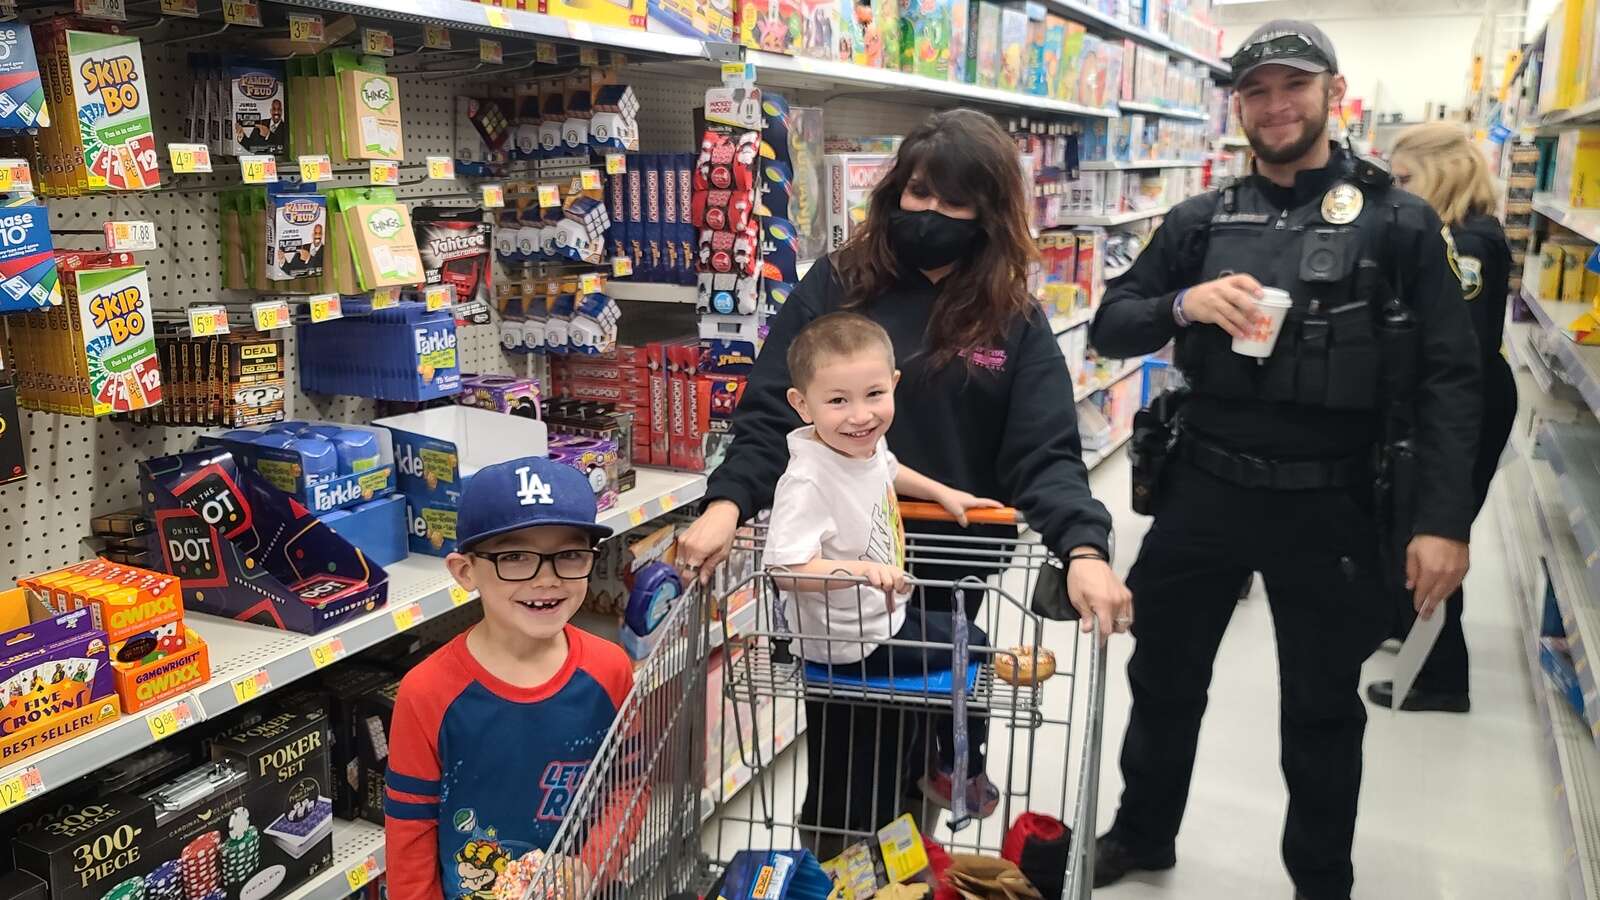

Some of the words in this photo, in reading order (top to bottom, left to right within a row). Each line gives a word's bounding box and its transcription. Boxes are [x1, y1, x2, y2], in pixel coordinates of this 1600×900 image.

[99, 83, 139, 116] BO
[137, 149, 159, 172] 12
[629, 171, 641, 222] MONOPOLY
[647, 171, 659, 222] MONOPOLY
[664, 171, 676, 223] MONOPOLY
[680, 171, 692, 223] MONOPOLY
[430, 235, 484, 256] Yahtzee
[108, 310, 145, 346] BO
[415, 328, 456, 355] Farkle
[244, 347, 274, 356] DEAL
[141, 369, 160, 392] 12
[575, 388, 620, 398] MONOPOLY
[652, 376, 664, 434] MONOPOLY
[671, 378, 684, 436] MONOPOLY
[199, 487, 216, 501] THE
[314, 480, 361, 511] Farkle
[515, 466, 554, 506] LA
[202, 489, 235, 524] OT
[184, 527, 199, 535] THE
[168, 536, 212, 564] DOT
[301, 581, 341, 598] DOT
[111, 594, 177, 629] QWIXX
[136, 661, 201, 701] QWIXX
[24, 690, 62, 712] FIVE
[2, 735, 37, 759] BEST
[41, 713, 94, 744] SELLER!
[232, 712, 297, 743] POKER
[263, 725, 289, 739] SET
[258, 730, 323, 777] POKER
[277, 758, 306, 783] SET
[45, 803, 110, 835] 300-
[64, 808, 121, 837] PIECE
[72, 825, 143, 873] 300-
[80, 846, 141, 888] PIECE
